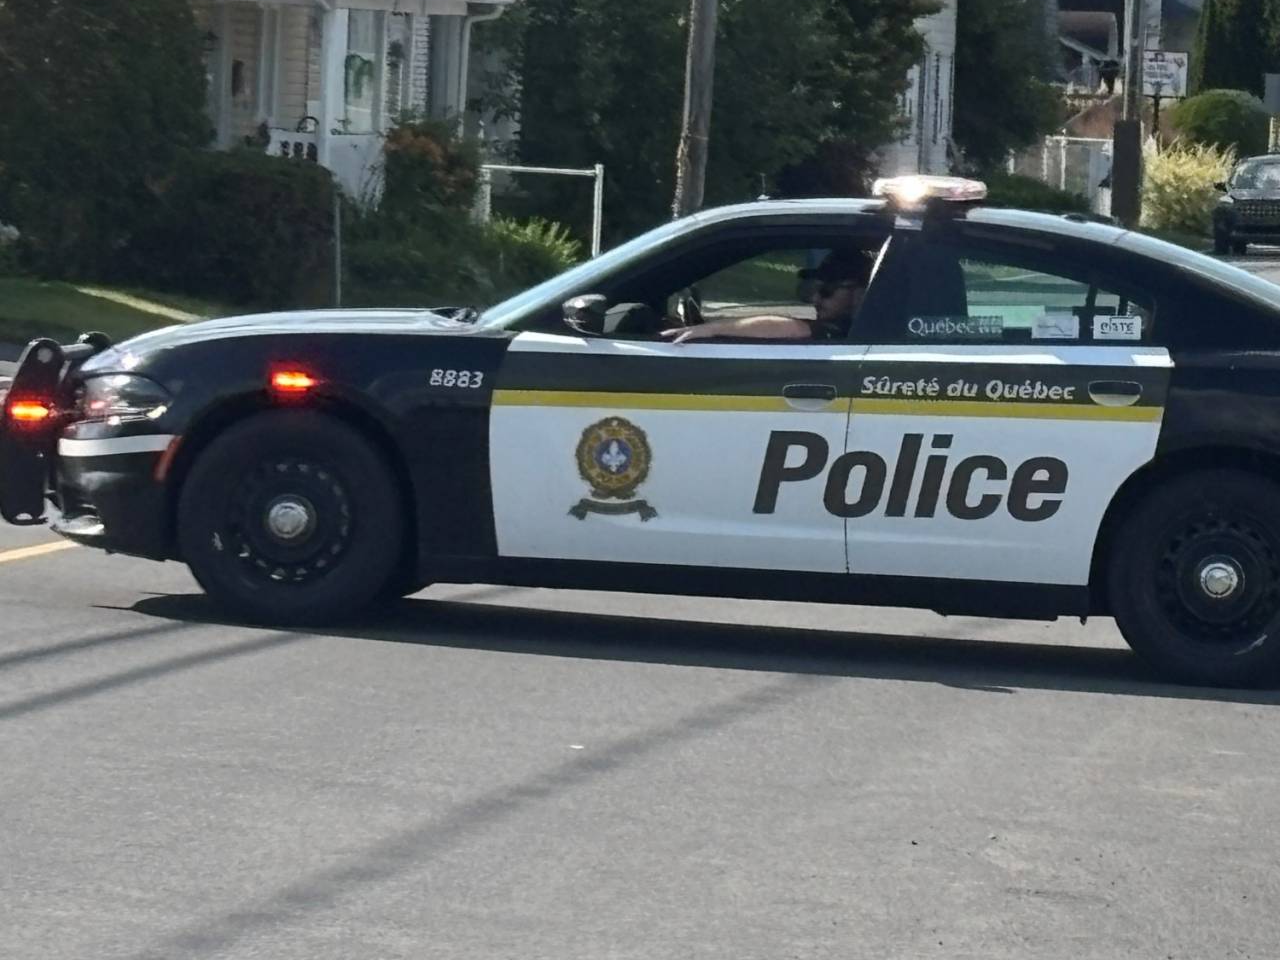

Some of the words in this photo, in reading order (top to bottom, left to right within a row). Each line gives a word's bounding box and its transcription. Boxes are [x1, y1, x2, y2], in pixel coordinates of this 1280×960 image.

[861, 376, 939, 396] Sûreté
[947, 379, 979, 397] du
[985, 380, 1076, 400] Québec
[752, 429, 1070, 522] Police
